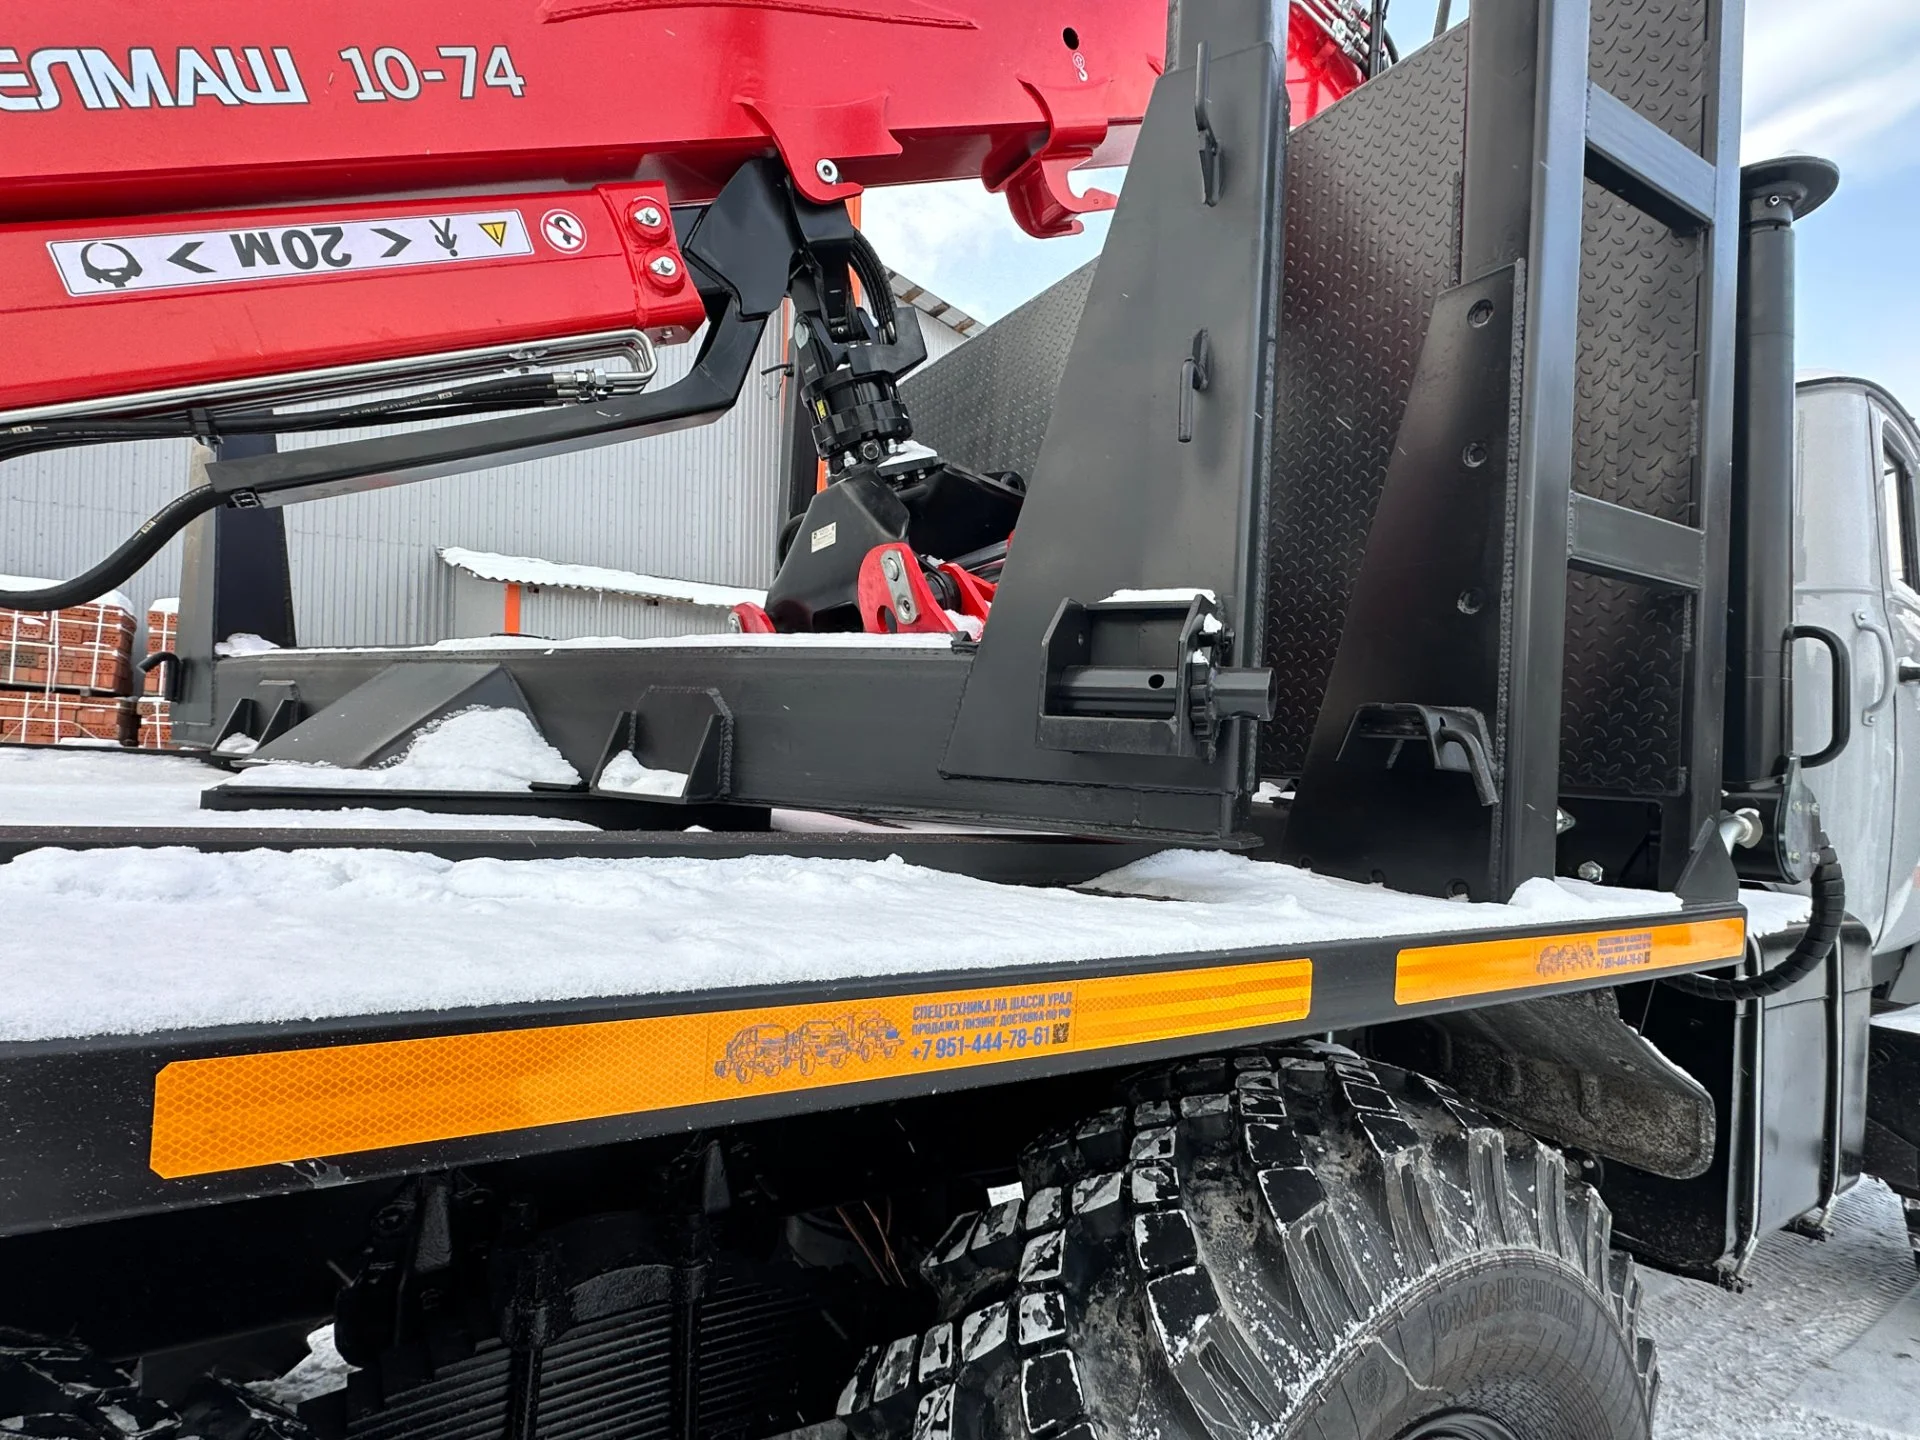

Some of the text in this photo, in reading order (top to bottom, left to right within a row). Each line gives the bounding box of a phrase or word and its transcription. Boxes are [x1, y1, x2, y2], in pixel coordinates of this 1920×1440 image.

[338, 45, 526, 103] 10-74
[911, 1007, 1072, 1036] ПРОДАЖА ЛИЗИНГ ДОСТАВКА ПО РФ
[912, 991, 1073, 1020] СПЕЦТЕХНИКА НА ШАССИ УРАЛ
[910, 1025, 1050, 1061] +7 951-444-78-61
[1432, 1276, 1584, 1339] OMSKSHINA
